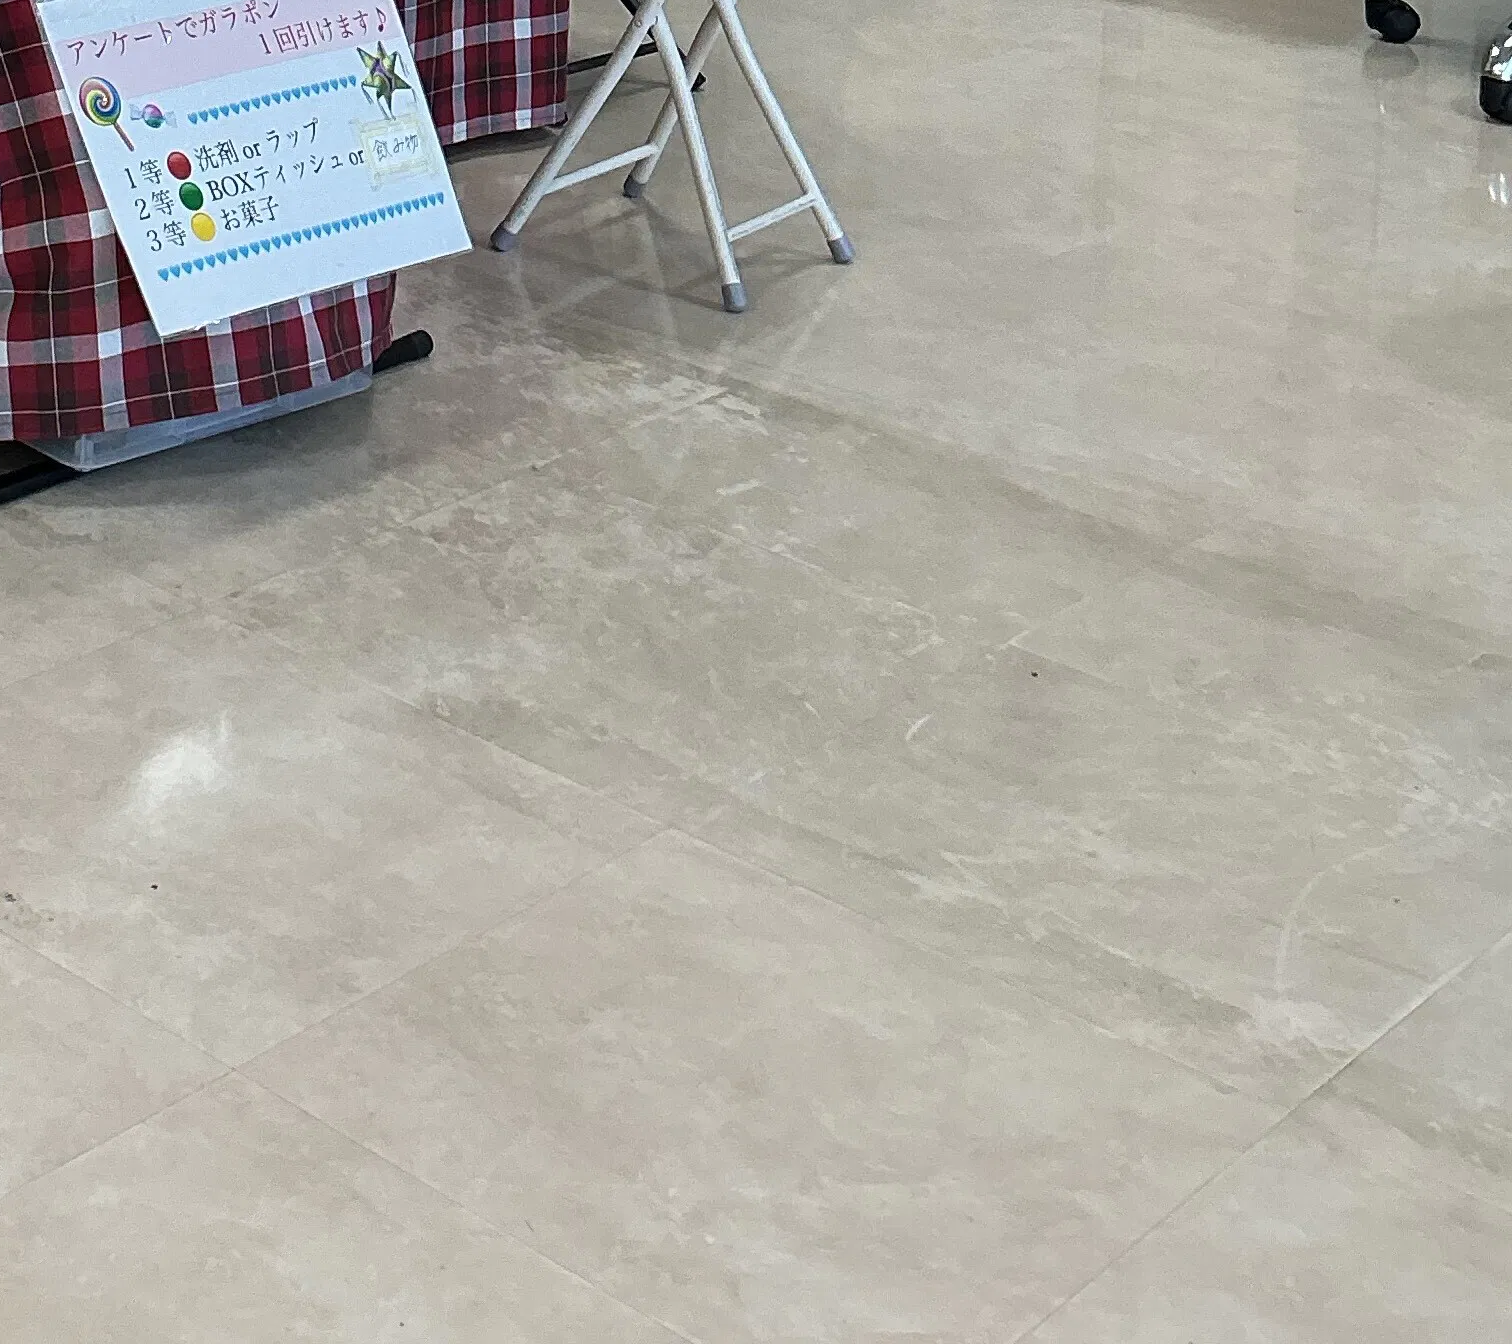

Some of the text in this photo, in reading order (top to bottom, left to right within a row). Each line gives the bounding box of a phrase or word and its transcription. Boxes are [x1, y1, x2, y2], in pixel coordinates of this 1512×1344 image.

[66, 0, 280, 67] アンケートでガラポン
[194, 140, 240, 173] 洗剤
[242, 144, 263, 160] or
[265, 116, 320, 155] ラップ
[134, 190, 176, 221] 2等
[348, 148, 366, 166] or
[146, 195, 281, 253] 3等 お菓子
